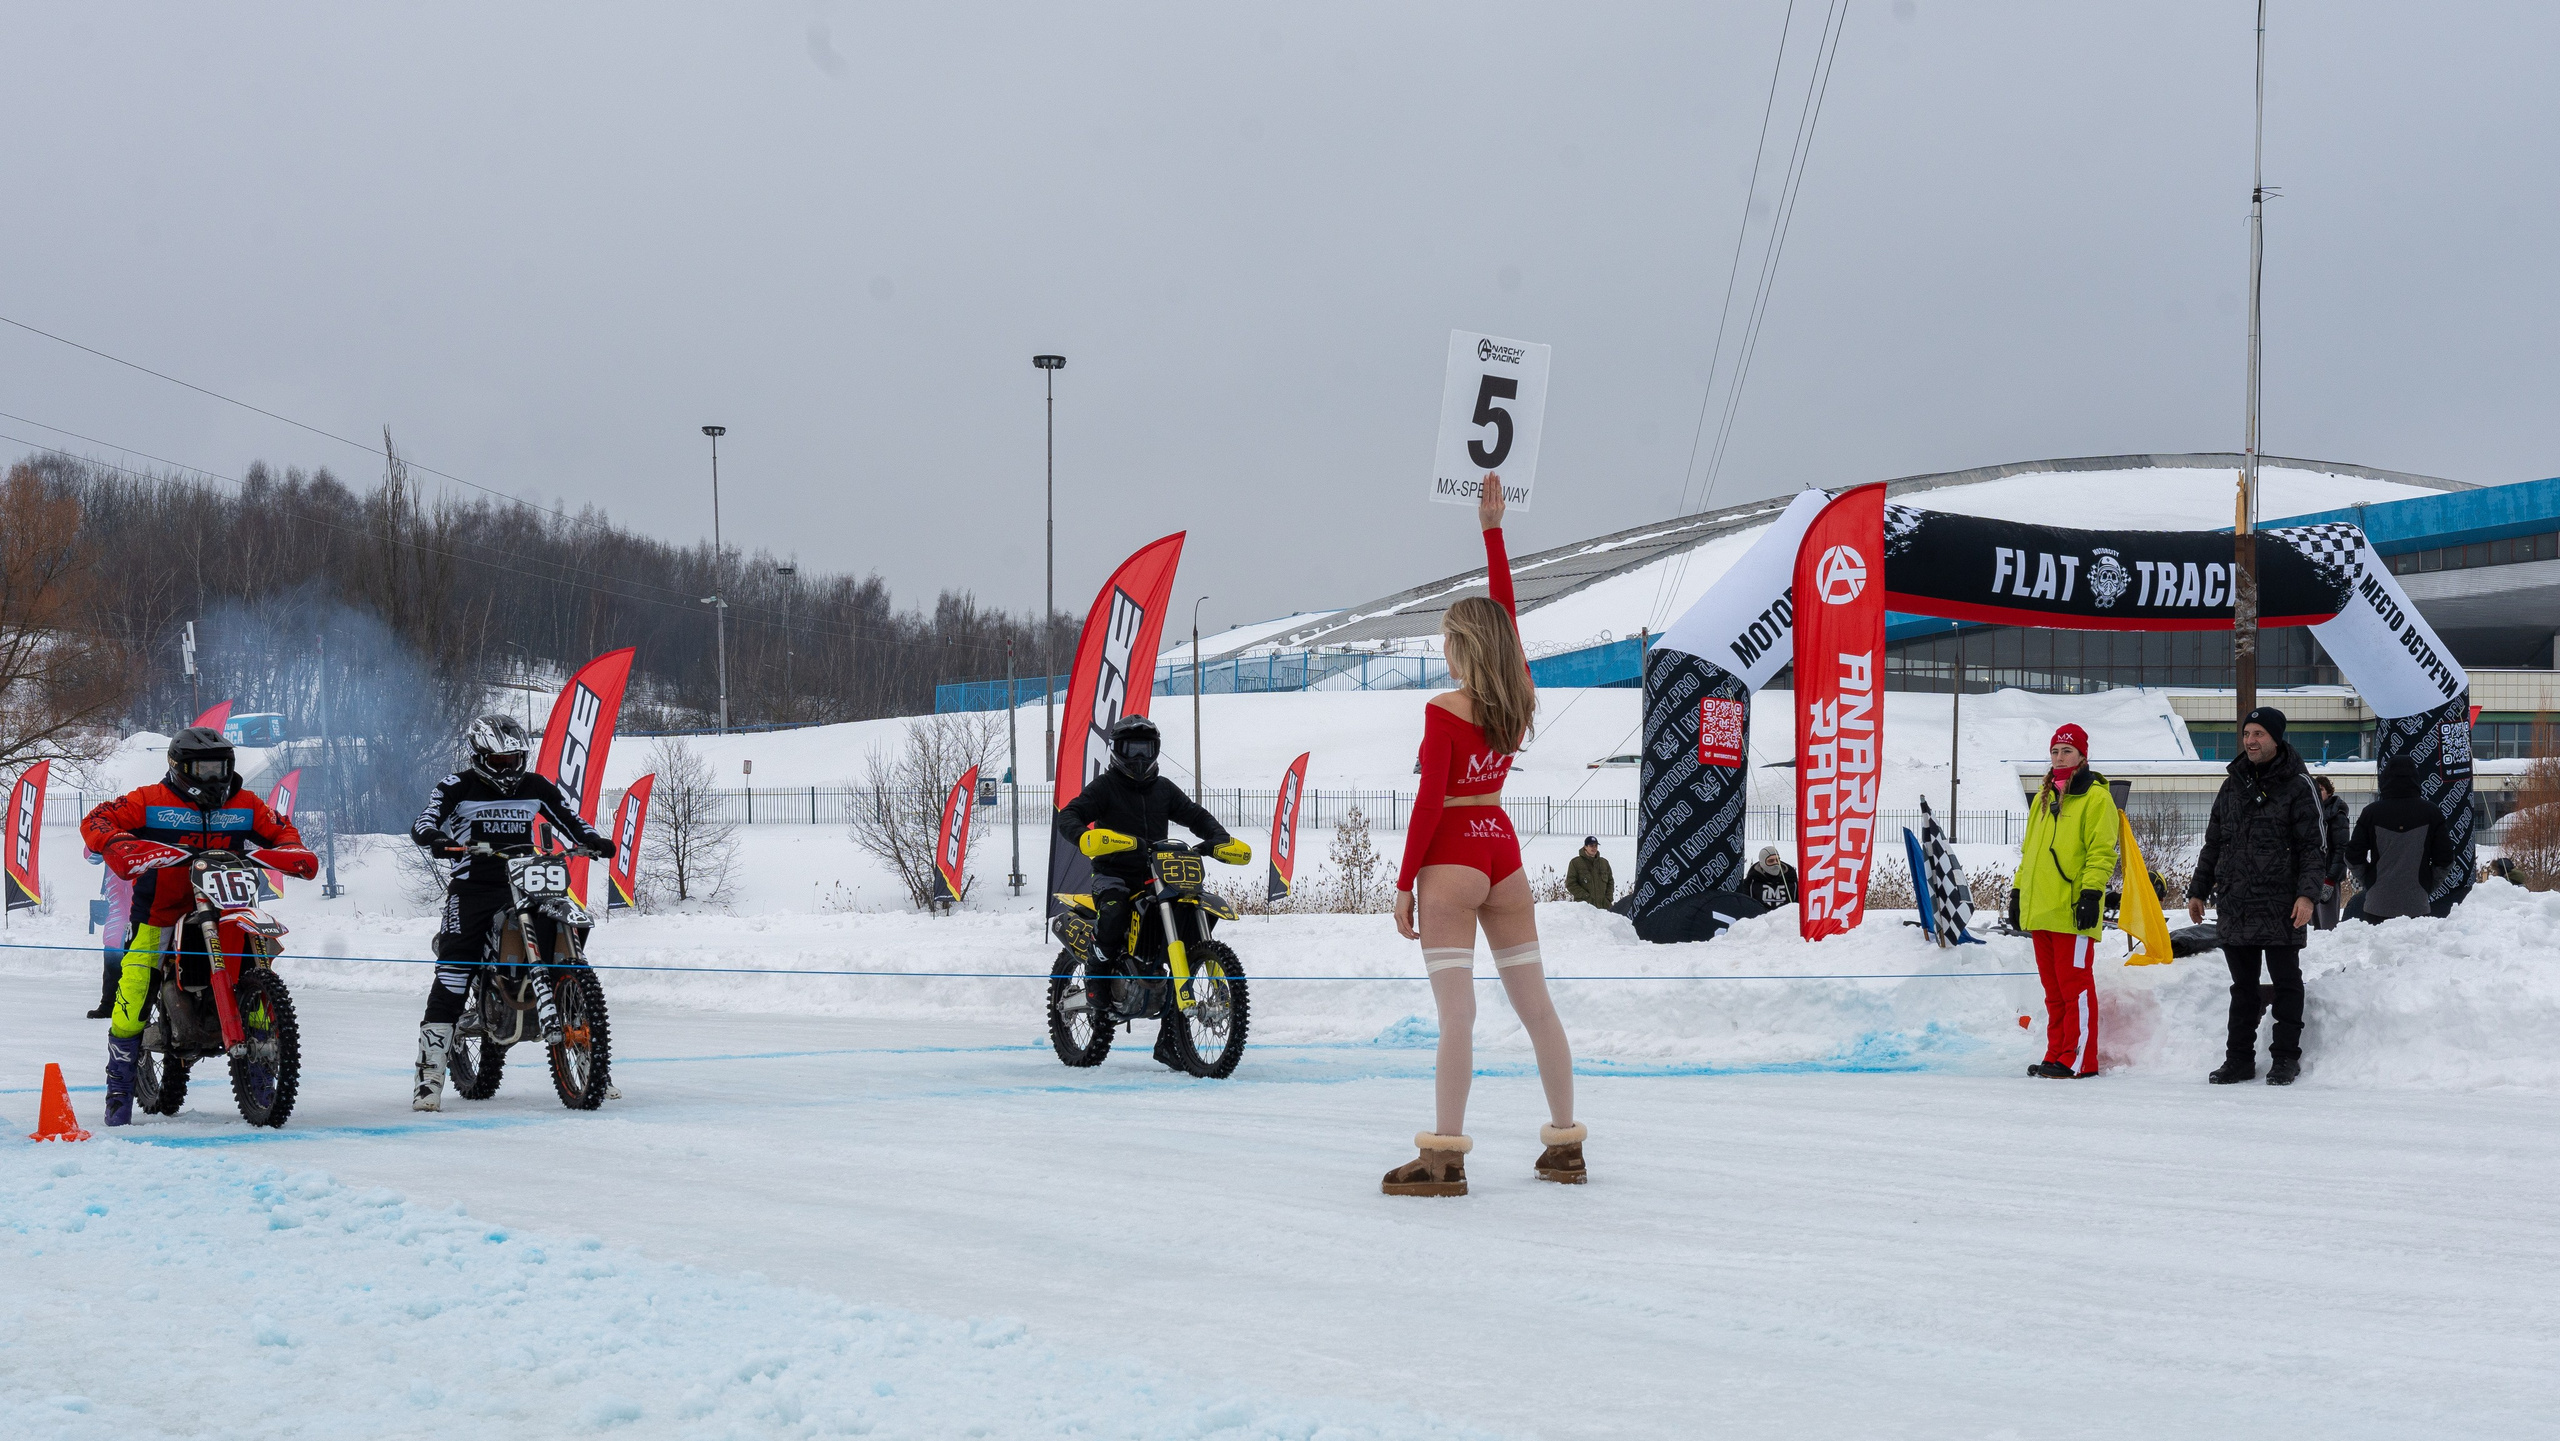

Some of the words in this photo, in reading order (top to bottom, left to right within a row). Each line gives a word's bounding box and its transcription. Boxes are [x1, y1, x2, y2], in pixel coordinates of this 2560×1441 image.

[1491, 352, 1520, 364] RACING
[1467, 374, 1518, 469] 5
[1437, 478, 1529, 504] MX-SPEWAY
[1992, 546, 2079, 601] FLAT
[2358, 572, 2405, 631] МЕСТО
[2399, 624, 2459, 700] ВСТРЕЧИ
[2057, 732, 2074, 742] MX
[1832, 649, 1876, 929] ANARCHY
[157, 810, 183, 828] Troy
[183, 811, 203, 825] Lee
[475, 808, 531, 819] ANARCHY
[1278, 769, 1298, 860] BSE
[1806, 697, 1838, 921] RACING
[17, 779, 38, 875] BSE
[483, 821, 526, 834] RACING
[618, 794, 640, 878] BSE
[946, 785, 968, 871] BSE
[1469, 817, 1503, 833] MX
[177, 833, 231, 850] KTM
[128, 850, 171, 865] RACING
[524, 865, 567, 892] 69
[1162, 859, 1202, 884] 36
